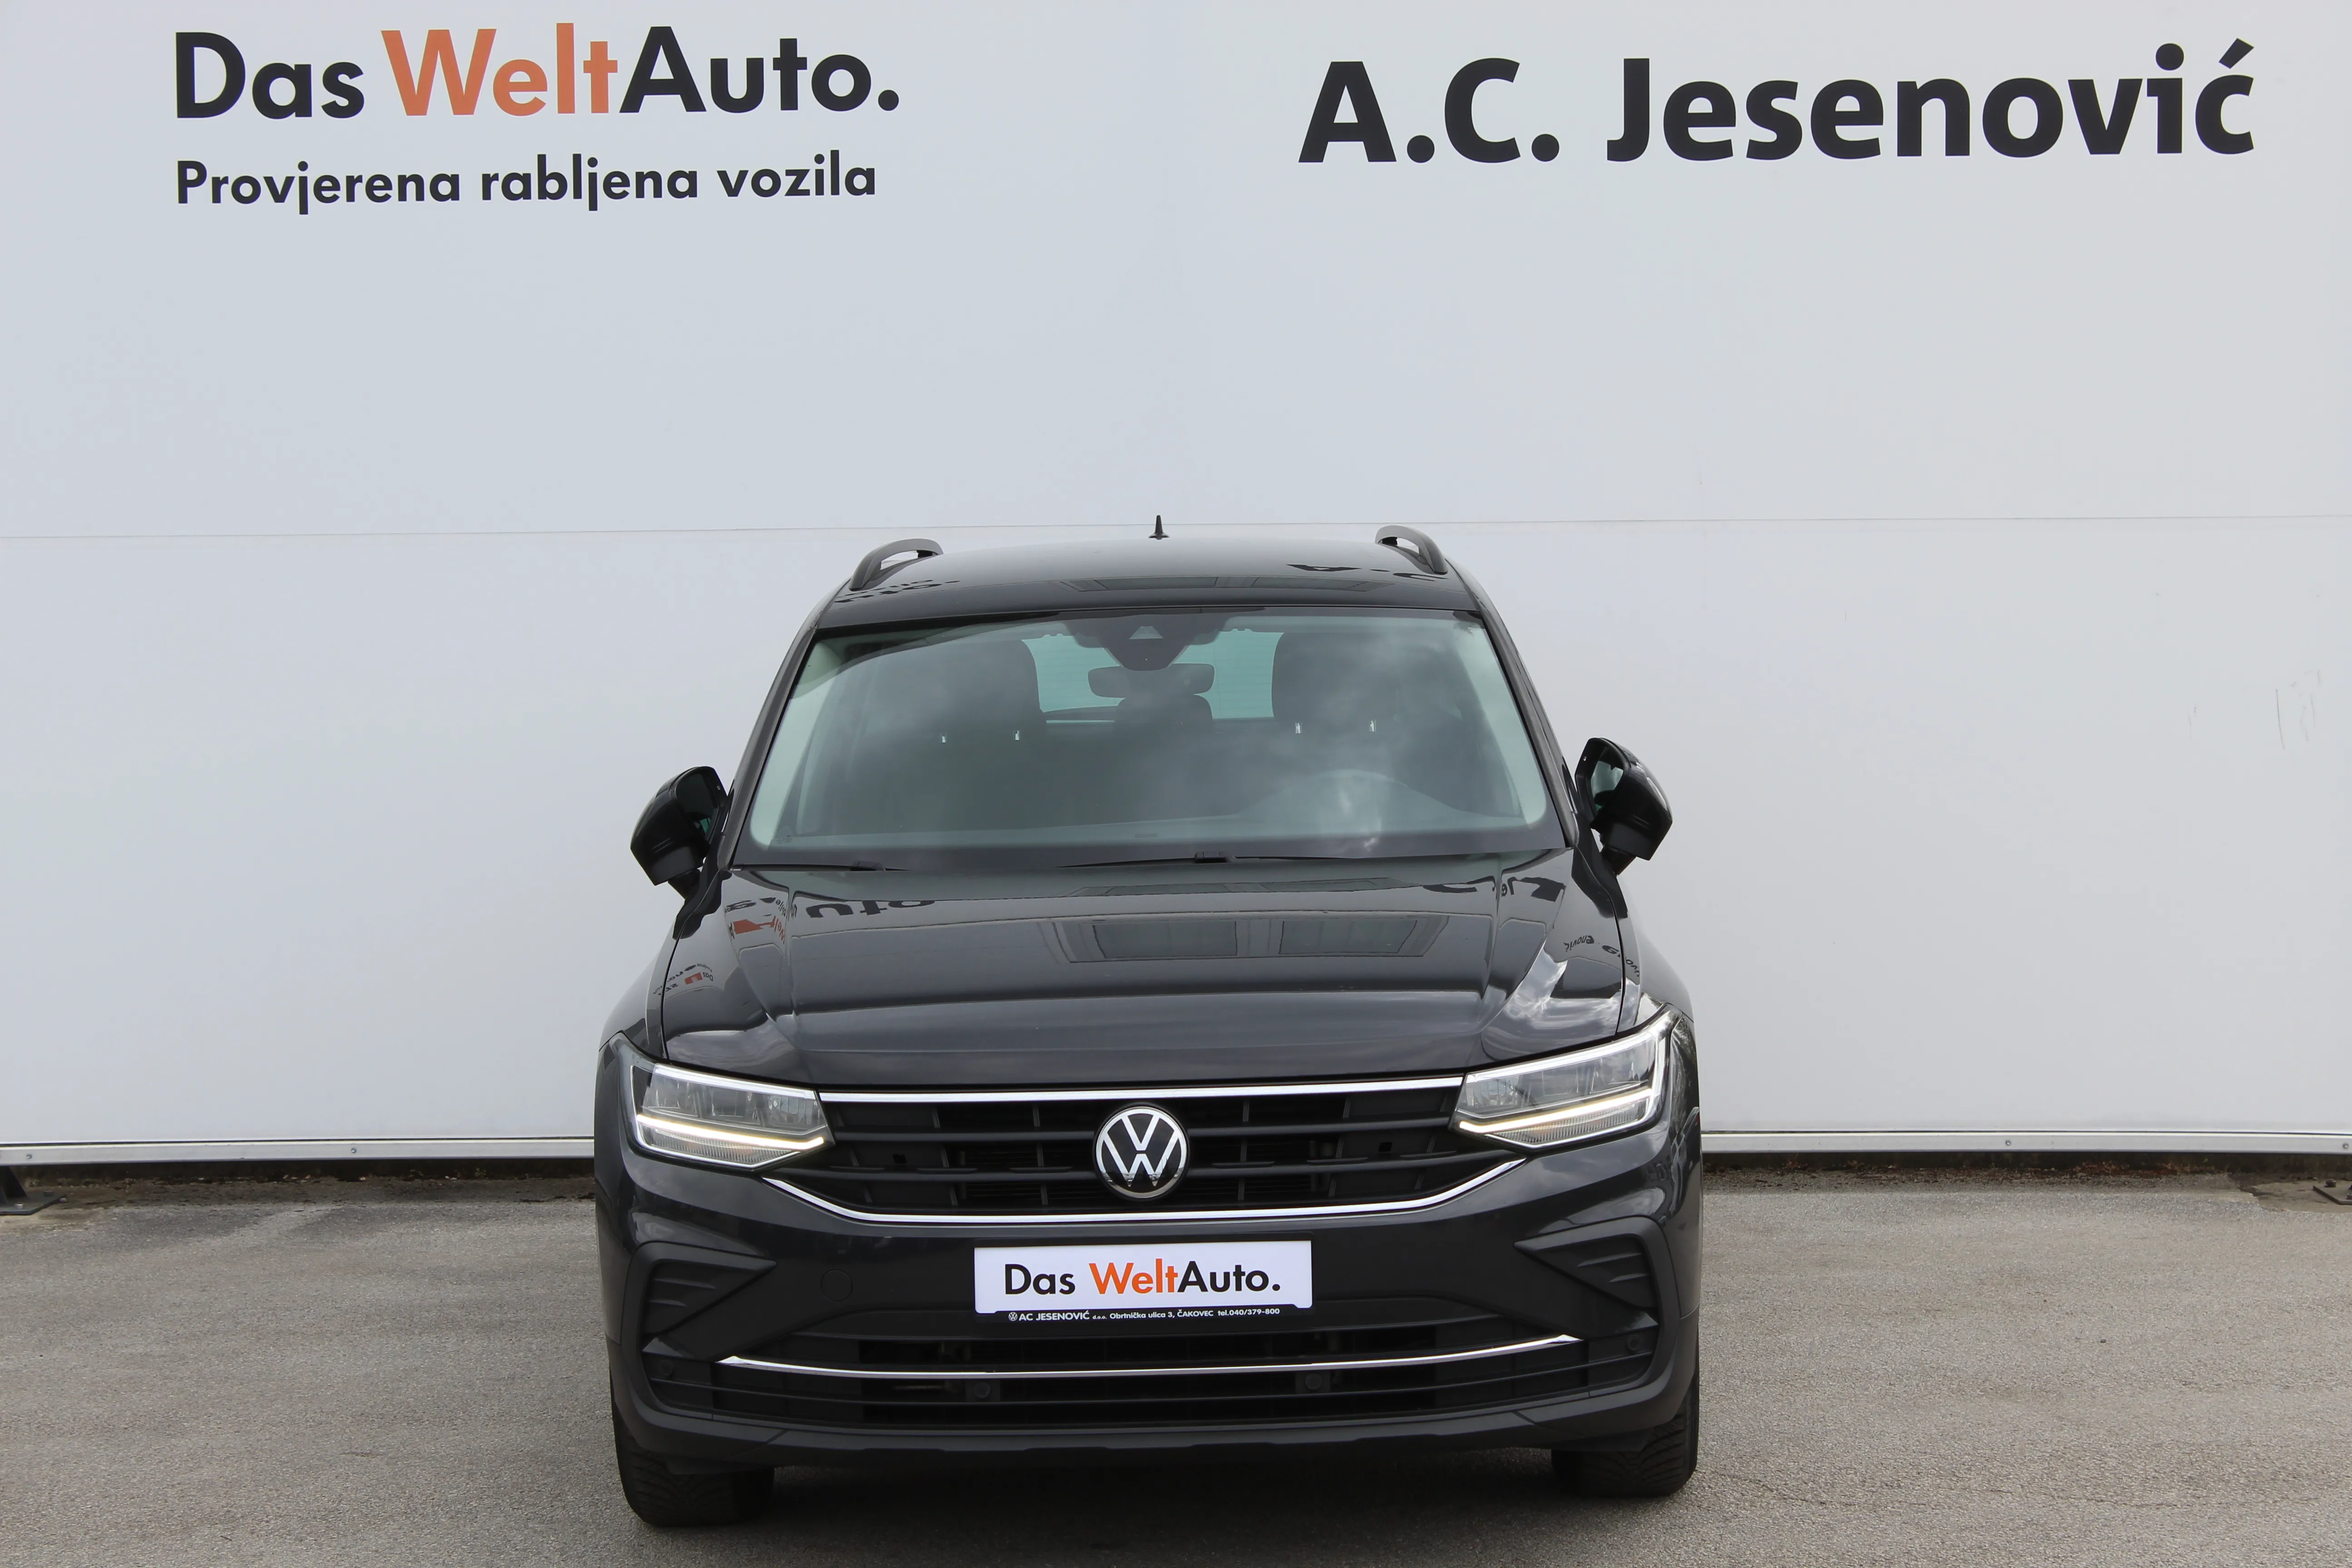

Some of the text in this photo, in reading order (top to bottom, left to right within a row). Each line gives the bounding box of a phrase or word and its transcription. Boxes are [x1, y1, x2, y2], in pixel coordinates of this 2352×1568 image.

[175, 23, 899, 120] Das WeltAuto.
[1298, 38, 2254, 163] A.C. Jesenović
[177, 149, 875, 215] Provjerena rabljena vozila
[1005, 1258, 1280, 1295] Das WeltAuto.
[1019, 1313, 1034, 1321] AC
[1035, 1310, 1090, 1321] JESENOVIĆ
[1177, 1309, 1214, 1318] ČAKOVEC
[1217, 1308, 1280, 1316] tel.040/379-800
